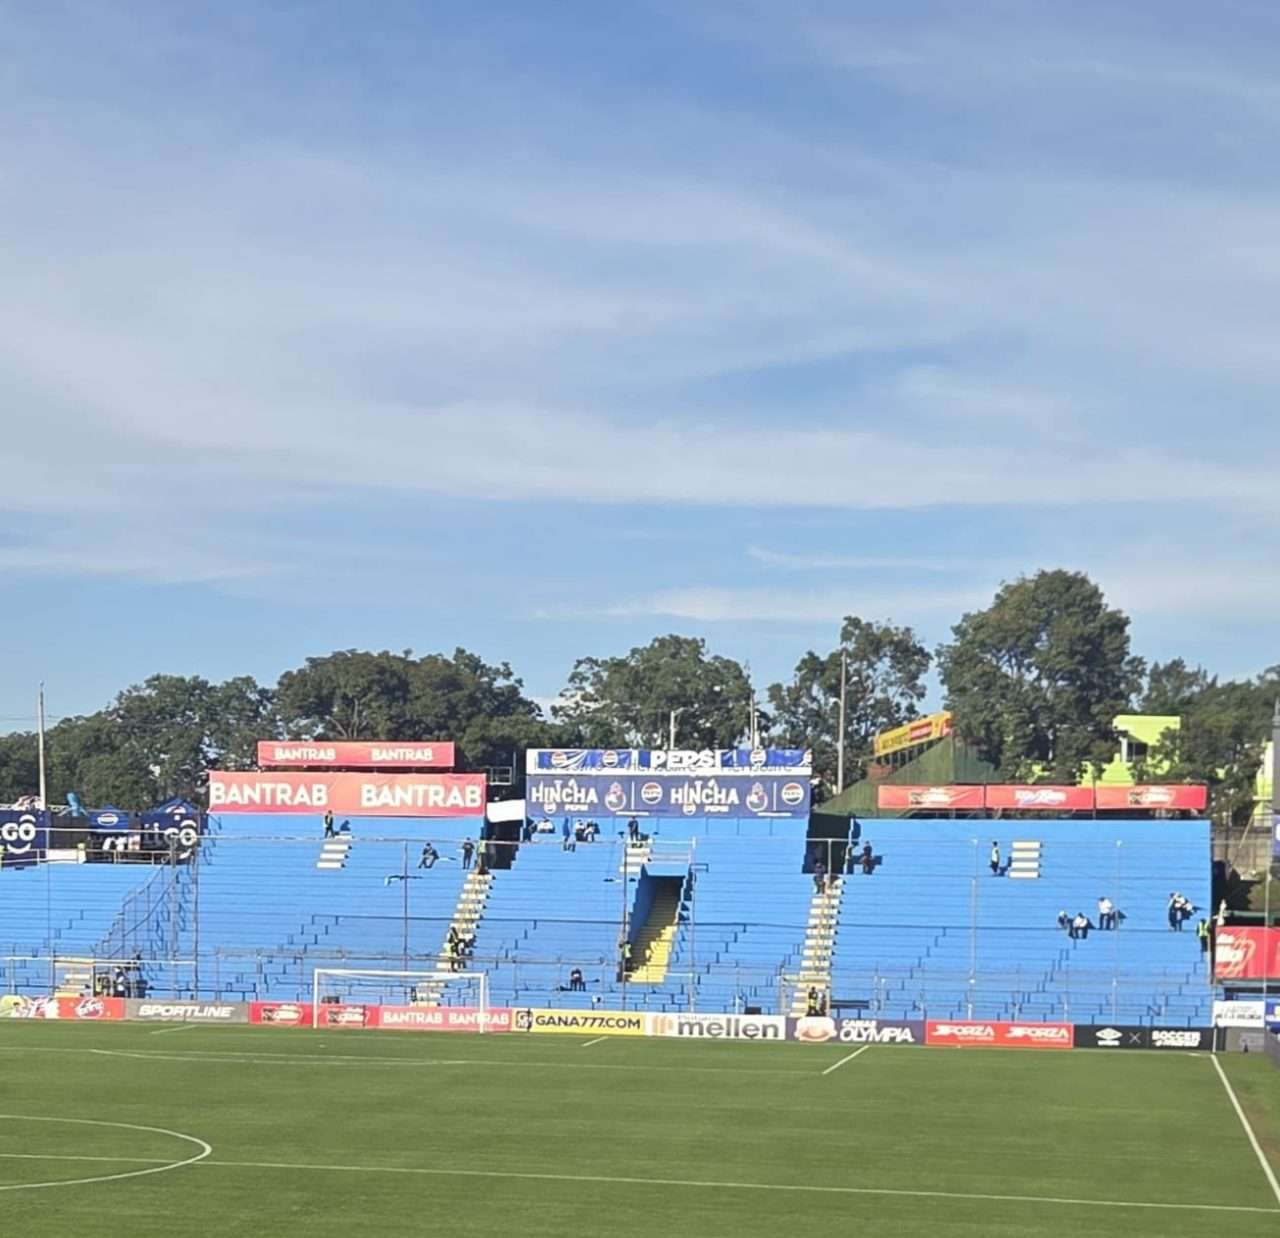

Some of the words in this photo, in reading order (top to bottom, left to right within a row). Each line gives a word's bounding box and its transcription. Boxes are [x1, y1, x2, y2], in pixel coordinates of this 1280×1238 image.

[274, 747, 336, 761] BANTRAB
[371, 747, 433, 762] BANTRAB
[650, 750, 721, 769] PEPSI
[210, 782, 328, 806] BANTRAB
[360, 784, 482, 808] BANTRAB
[531, 779, 599, 803] HINCHA
[670, 779, 740, 805] HINCHA
[138, 1003, 234, 1018] SPORTLINE
[383, 1011, 443, 1026] BANTRAB
[535, 1014, 641, 1030] GANA777.COM
[678, 1017, 779, 1039] mellen
[839, 1026, 915, 1043] OLYMPIA
